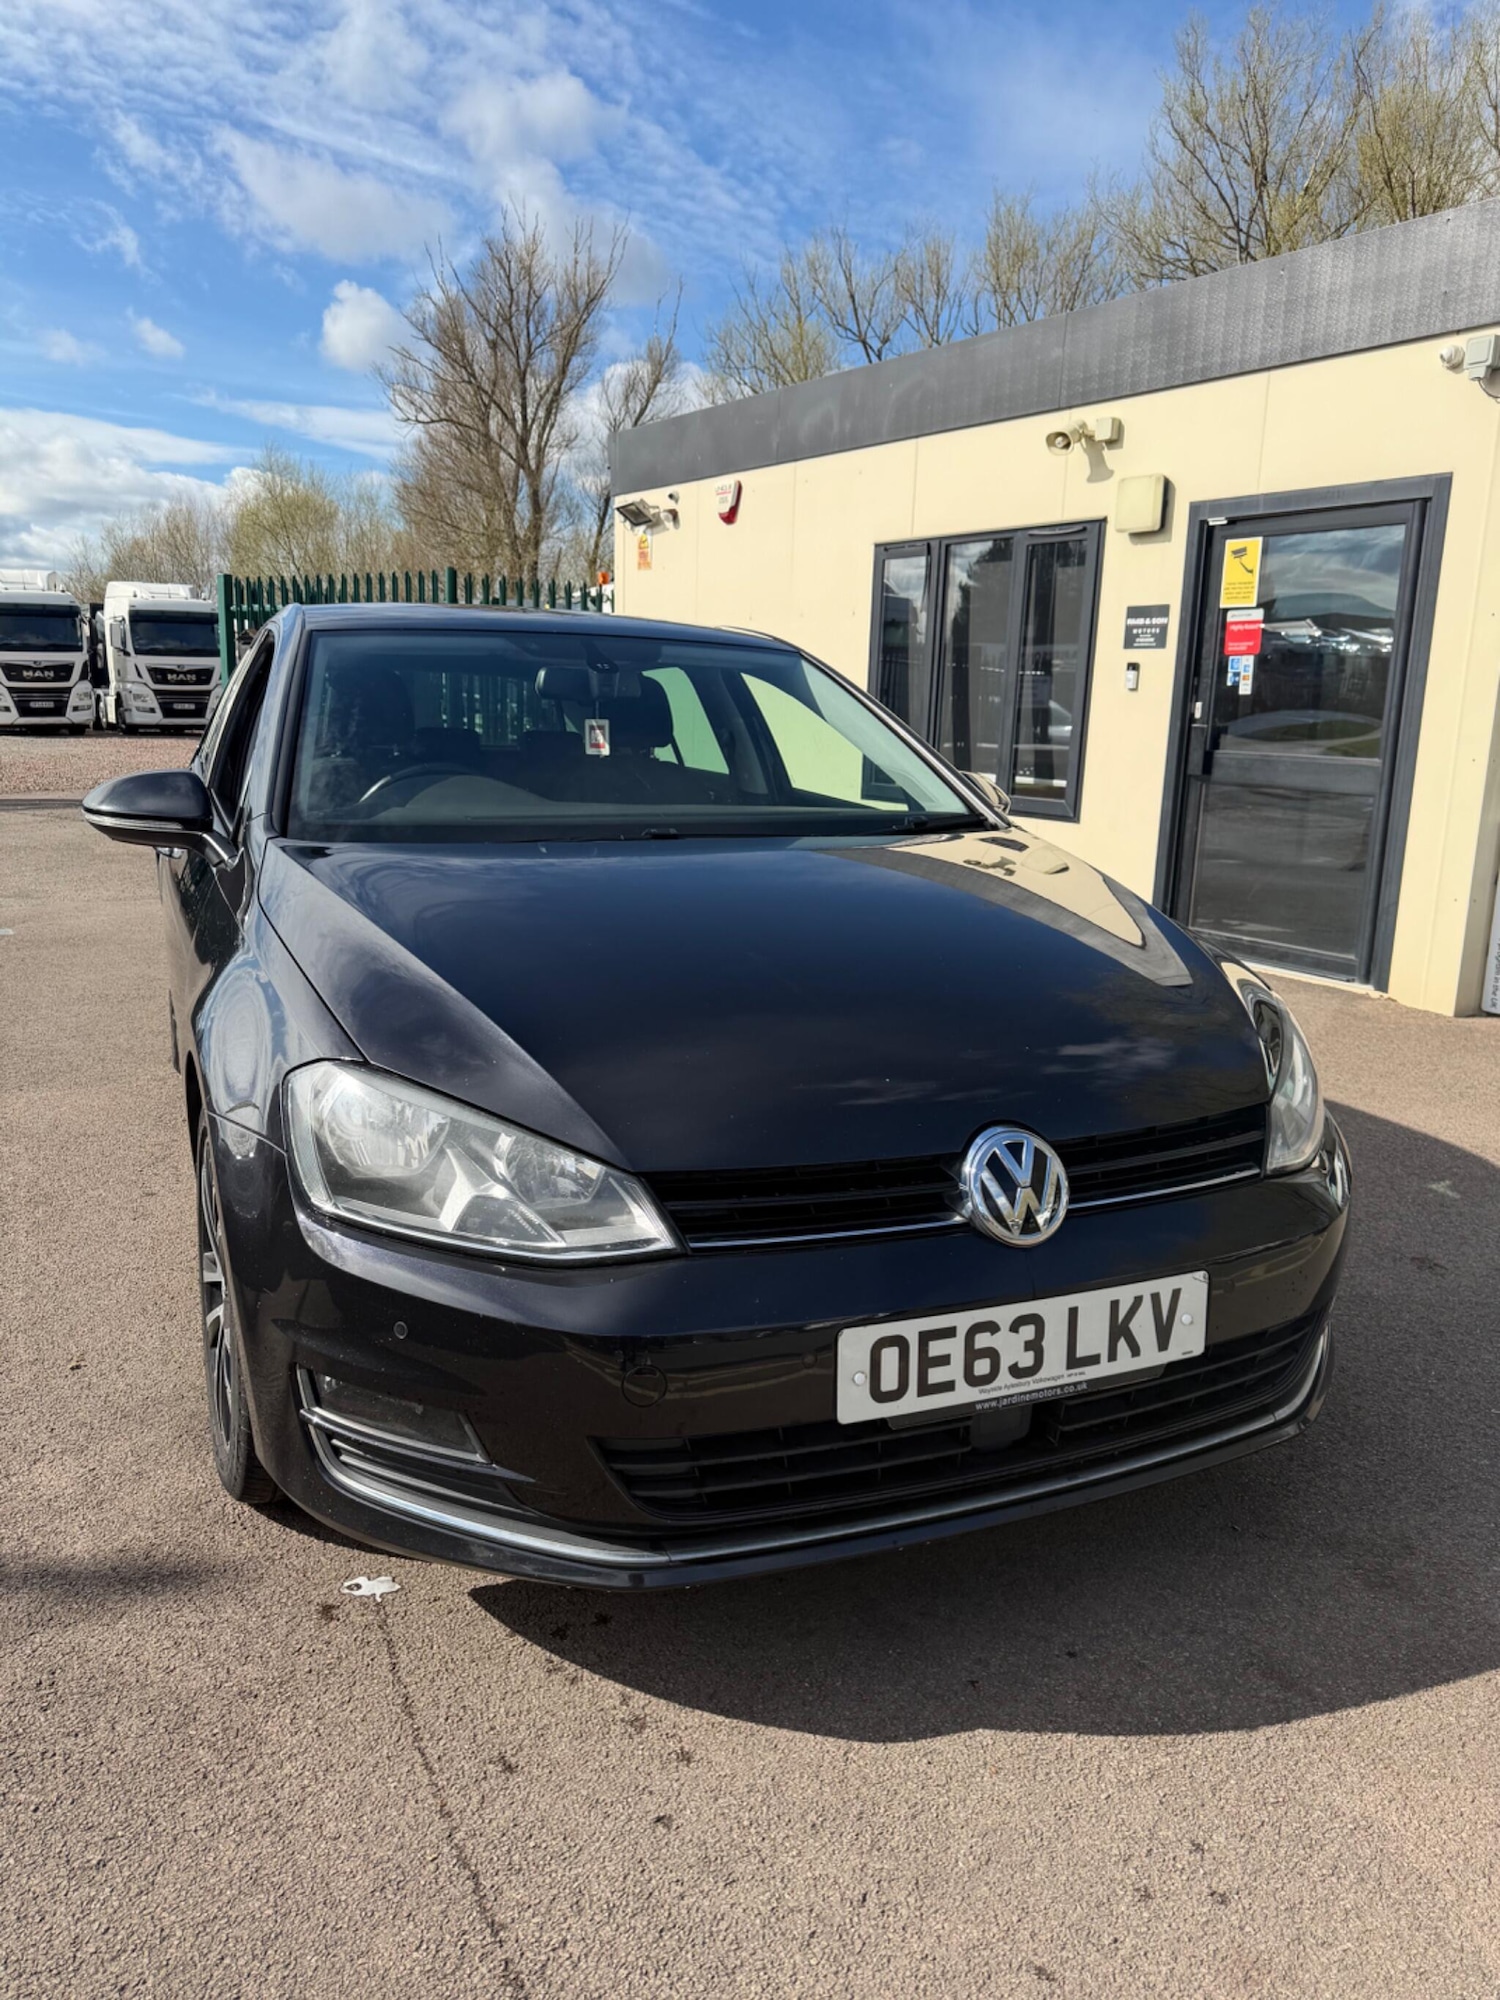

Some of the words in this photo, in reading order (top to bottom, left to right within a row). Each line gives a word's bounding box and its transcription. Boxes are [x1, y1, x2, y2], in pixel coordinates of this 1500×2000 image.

[22, 670, 55, 680] MAN
[167, 674, 197, 683] MAN
[869, 1313, 1045, 1404] OE63
[1066, 1288, 1182, 1371] LKV
[975, 1381, 1088, 1410] www.jardinemotors.co.uk
